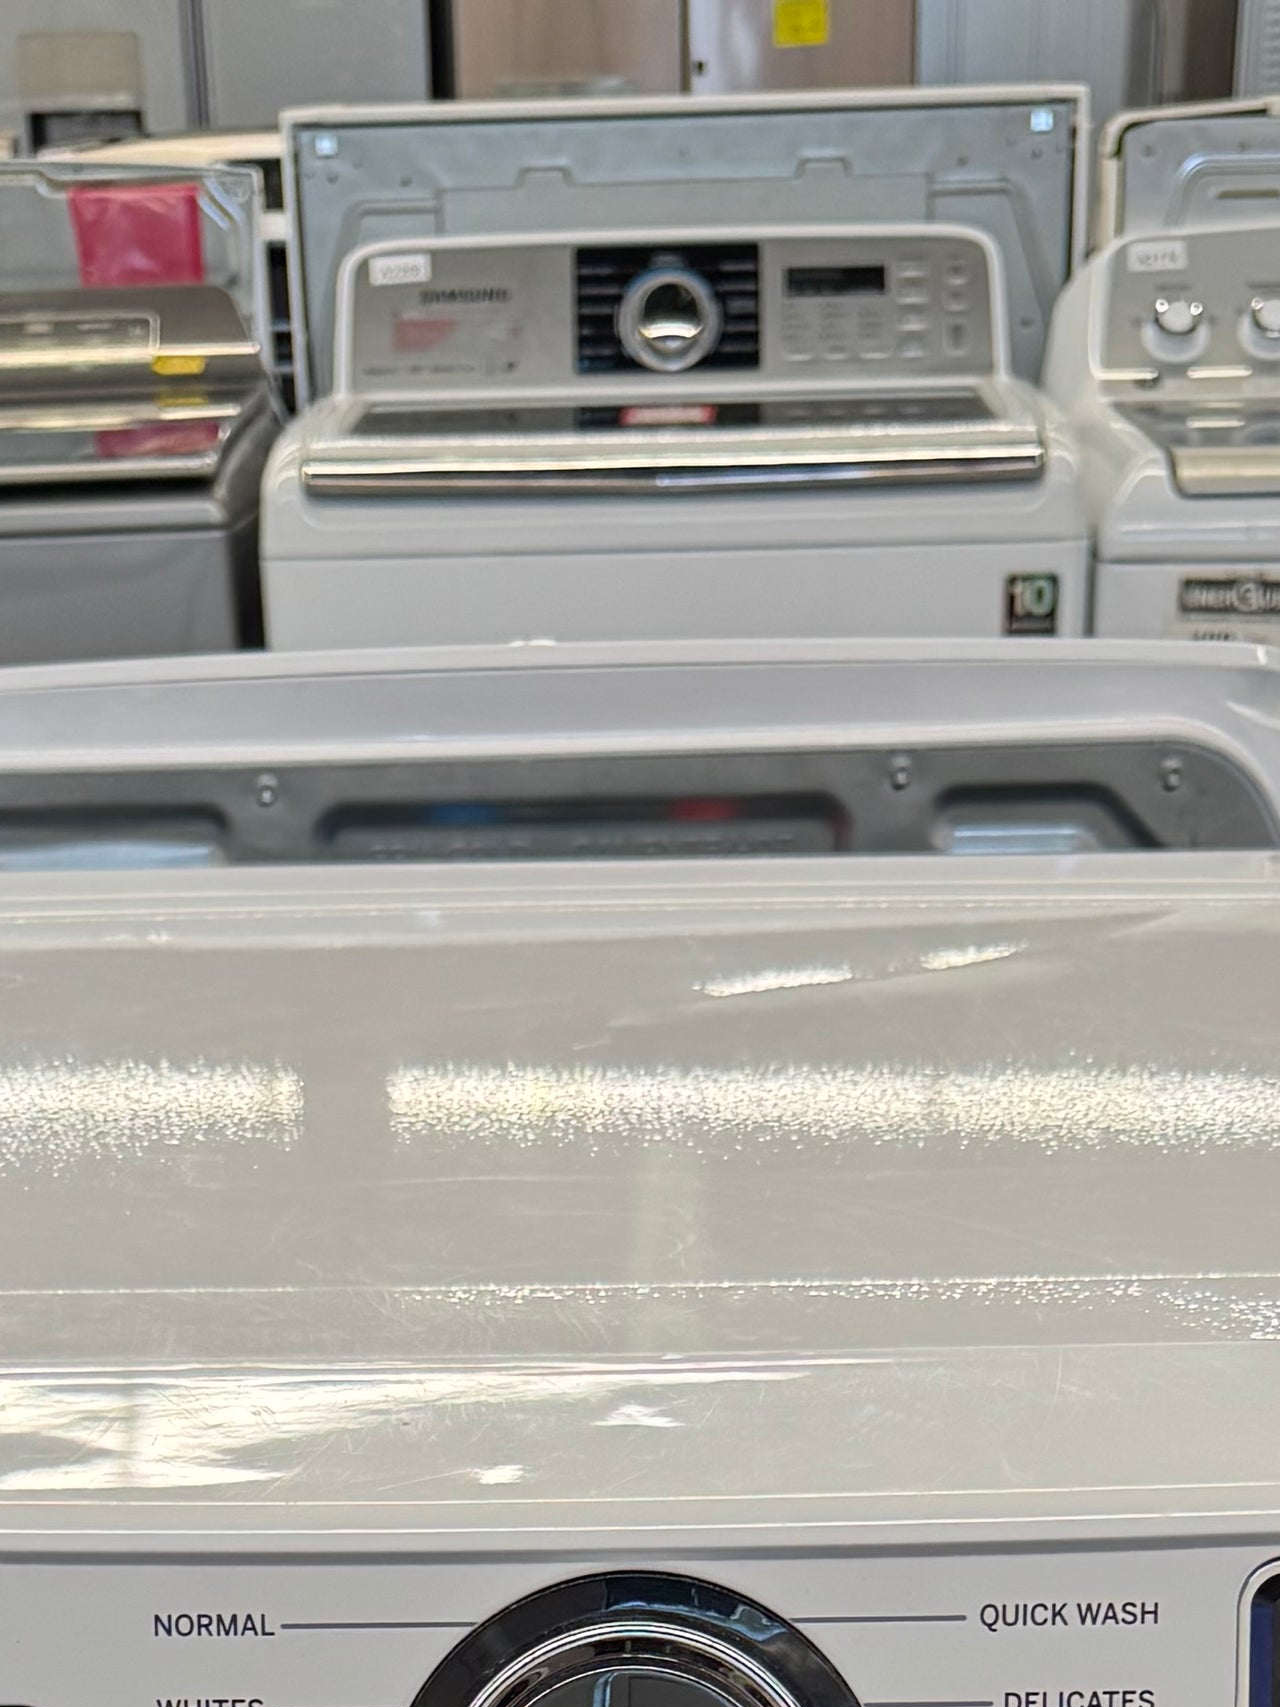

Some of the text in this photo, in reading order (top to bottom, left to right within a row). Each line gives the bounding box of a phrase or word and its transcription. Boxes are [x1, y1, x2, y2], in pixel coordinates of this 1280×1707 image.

[155, 1614, 275, 1636] NORMAL
[980, 1602, 1158, 1632] QUICK WASH
